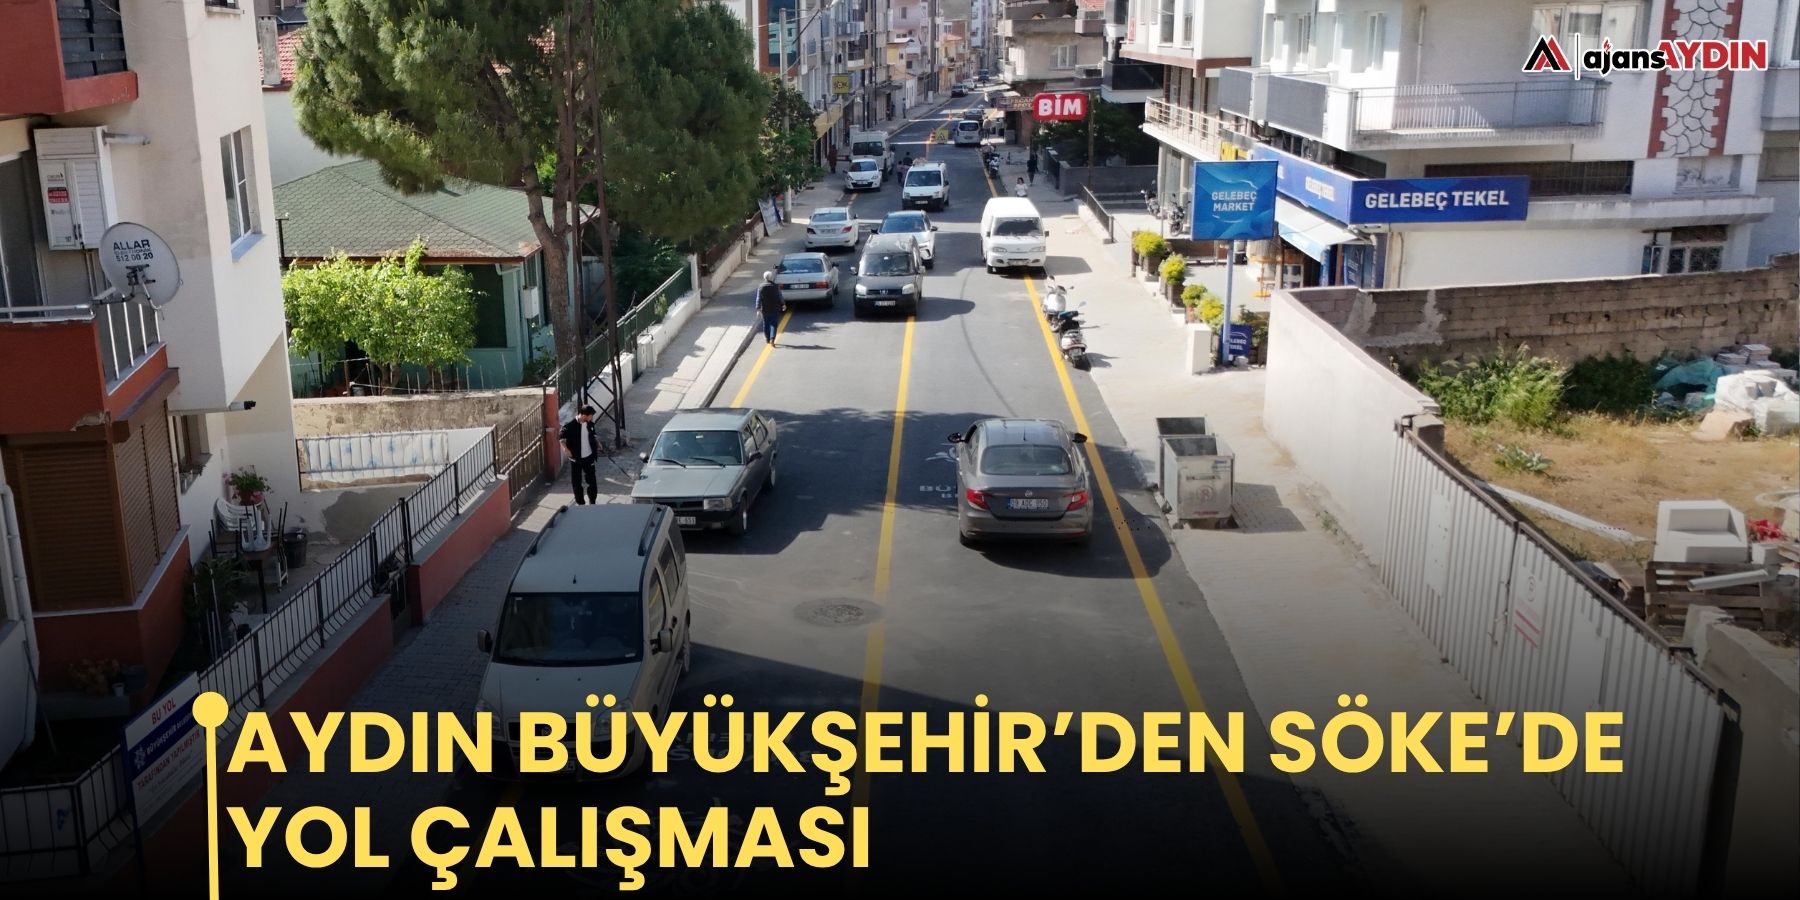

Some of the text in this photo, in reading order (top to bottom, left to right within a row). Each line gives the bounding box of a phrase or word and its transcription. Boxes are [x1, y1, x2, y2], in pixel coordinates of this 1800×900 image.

[1038, 94, 1082, 116] BİM
[1211, 191, 1257, 202] GELEBEÇ
[1365, 190, 1510, 211] GELEBEÇ TEKEL
[1213, 202, 1254, 212] MARKET
[113, 239, 151, 251] ALLAR
[116, 252, 154, 262] 512 00 20
[151, 697, 177, 725] BU YOL
